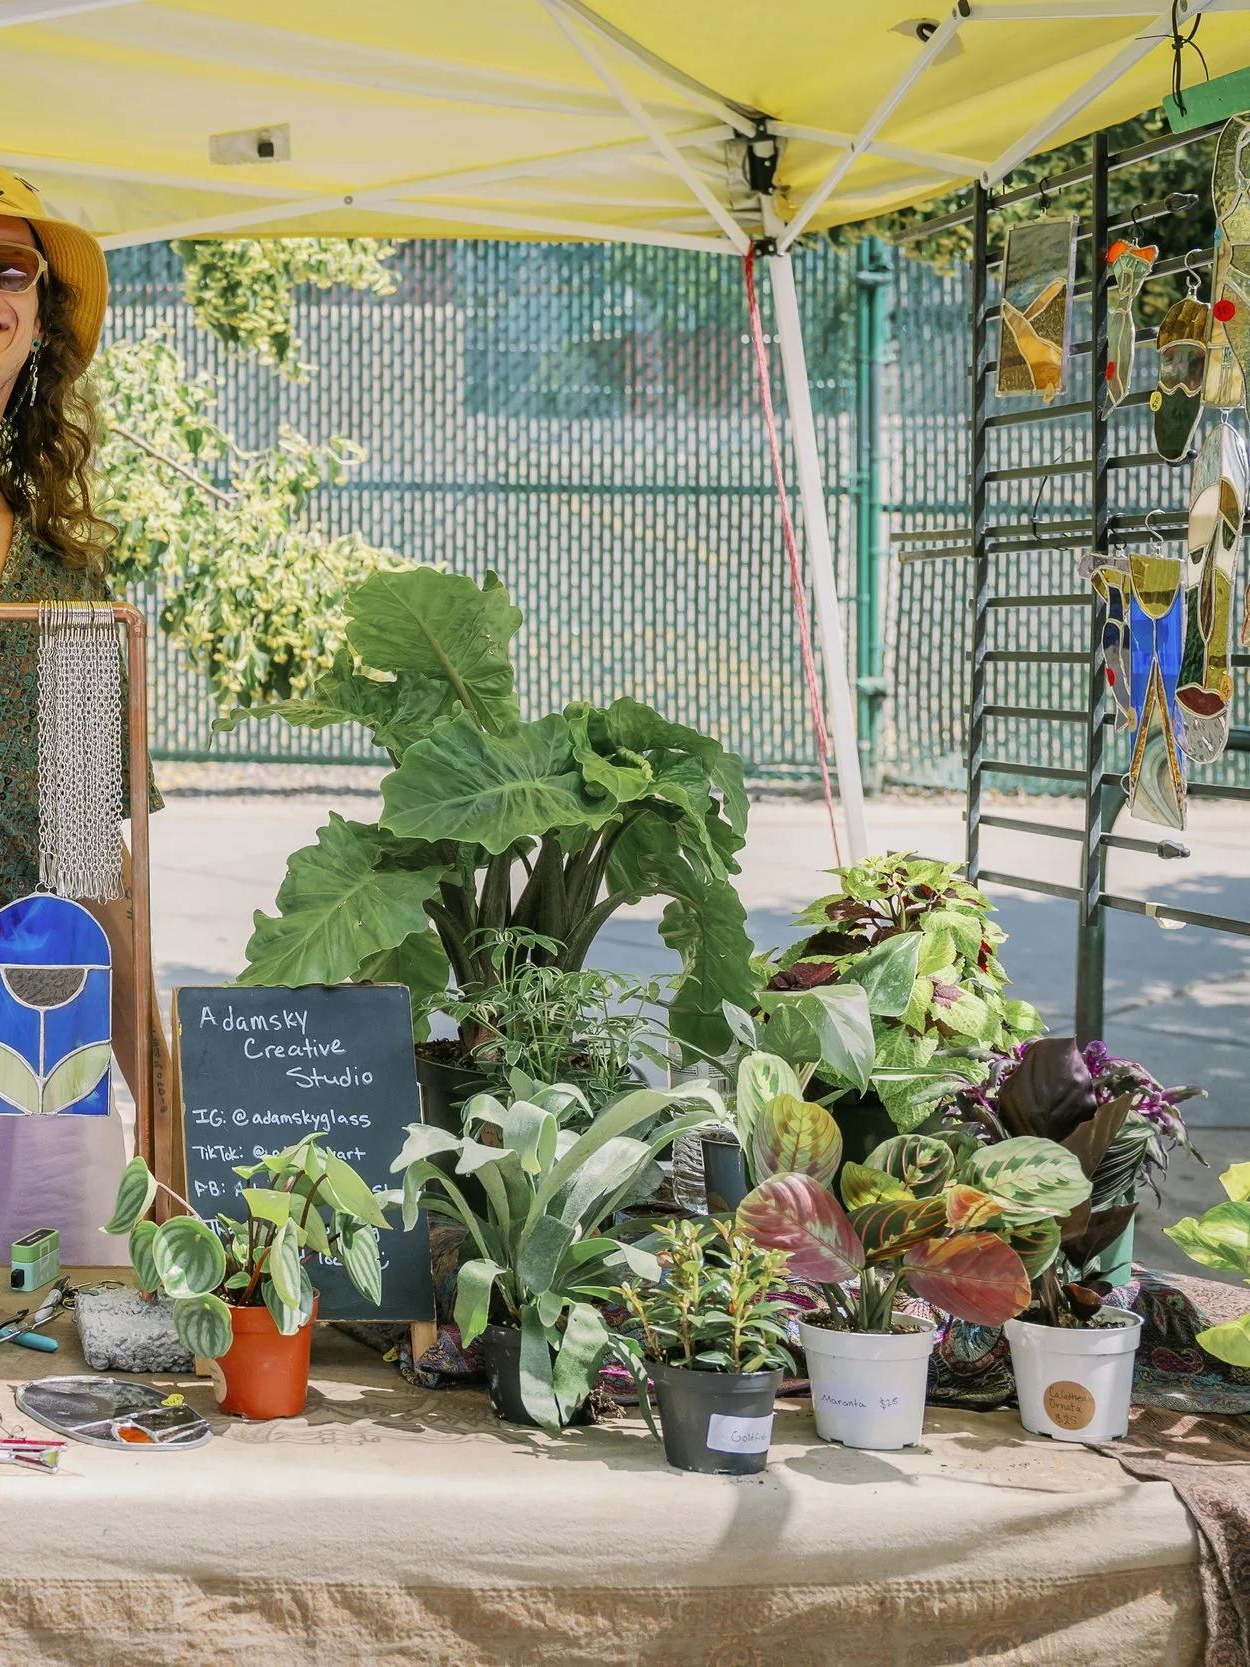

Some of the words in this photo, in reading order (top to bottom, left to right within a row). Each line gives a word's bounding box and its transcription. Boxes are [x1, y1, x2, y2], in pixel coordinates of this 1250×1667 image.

[199, 1005, 308, 1035] Adamsky
[243, 1037, 347, 1060] Creative
[285, 1066, 373, 1089] Studio
[192, 1108, 227, 1128] IG:
[231, 1107, 372, 1132] @adamskyglass
[192, 1145, 244, 1162] TikTok:
[194, 1179, 226, 1198] FB:
[821, 1393, 867, 1408] Maranta
